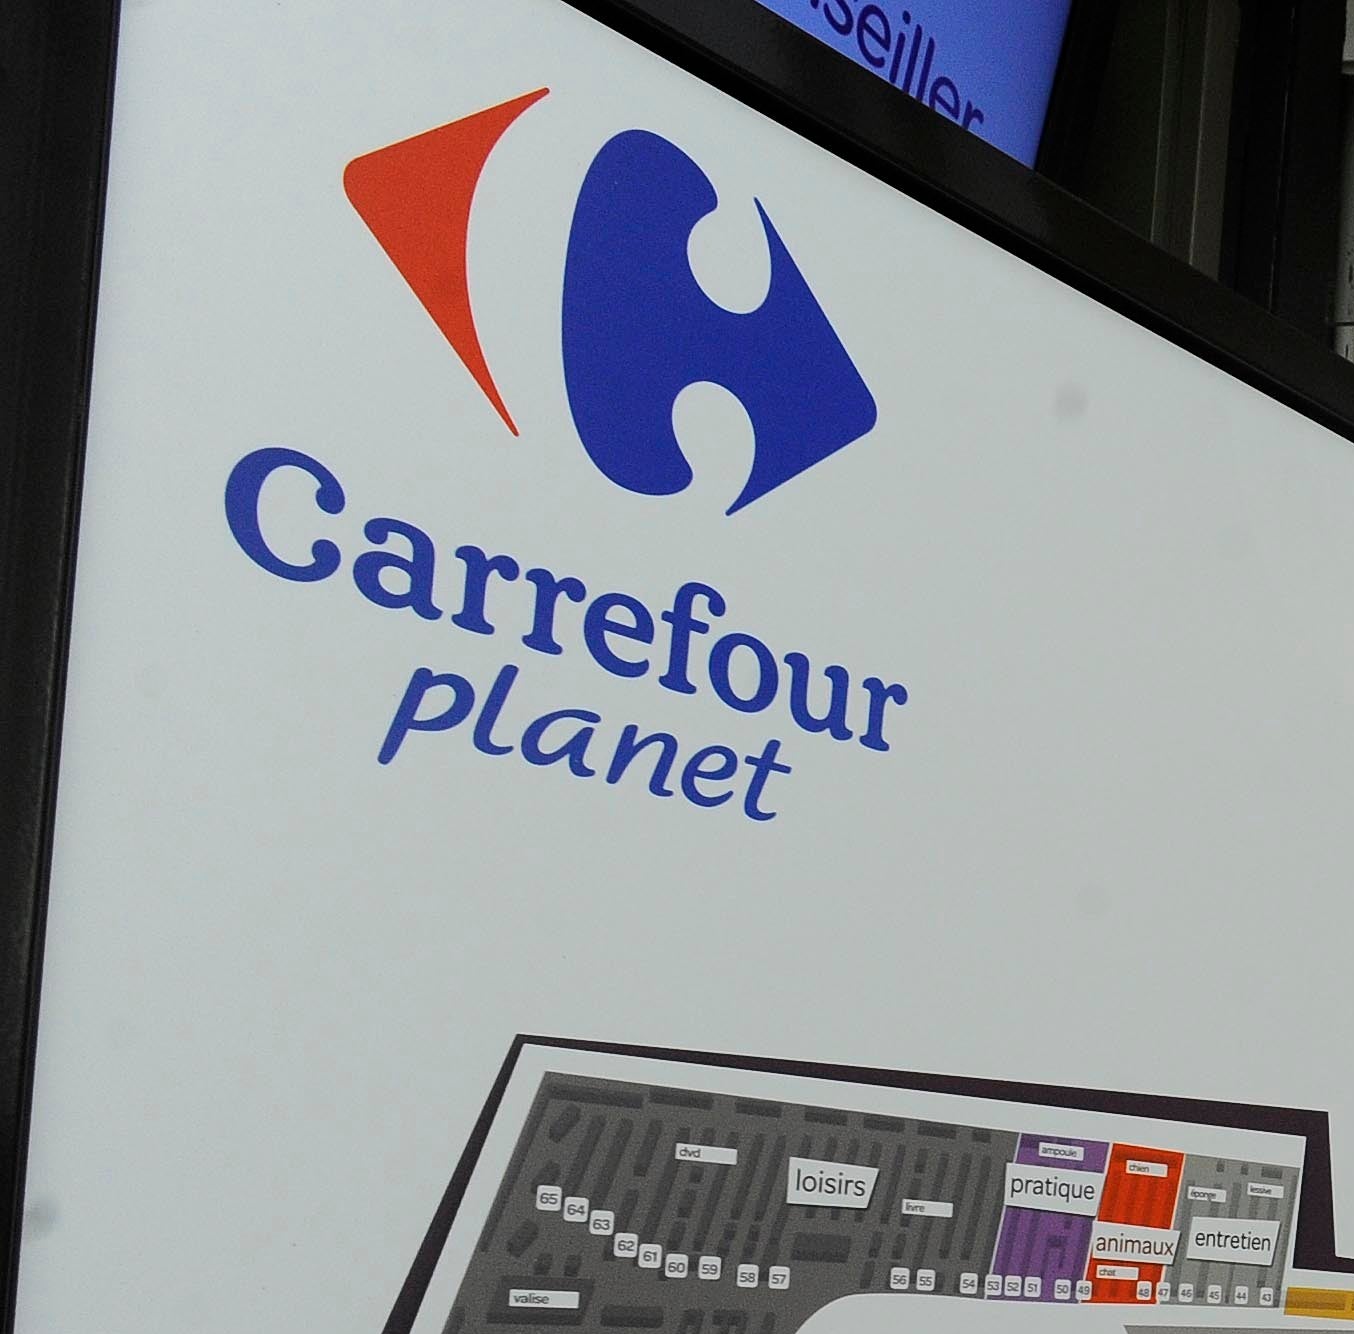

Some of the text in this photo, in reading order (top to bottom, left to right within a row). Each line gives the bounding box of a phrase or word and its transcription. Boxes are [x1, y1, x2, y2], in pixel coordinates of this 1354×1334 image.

[810, 0, 984, 131] seiller
[224, 446, 907, 752] Carrefour
[378, 663, 792, 821] planet
[679, 1146, 700, 1158] dvd
[1041, 1146, 1077, 1158] ampoule
[1129, 1163, 1150, 1173] chien
[795, 1169, 866, 1197] loisirs
[1010, 1176, 1095, 1203] pratique
[539, 1191, 559, 1206] 65
[566, 1203, 586, 1216] 64
[593, 1218, 611, 1231] 63
[617, 1239, 635, 1252] 62
[1095, 1232, 1174, 1256] animaux
[1194, 1230, 1271, 1251] entretien
[643, 1250, 658, 1263] 61
[667, 1261, 686, 1274] 60
[701, 1262, 719, 1275] 59
[739, 1271, 756, 1284] 58
[771, 1272, 787, 1285] 57
[892, 1273, 908, 1286] 56
[918, 1274, 934, 1287] 55
[962, 1277, 976, 1289] 54
[987, 1280, 1000, 1291] 53
[1007, 1281, 1020, 1292] 52
[1026, 1282, 1038, 1293] 51
[1057, 1284, 1069, 1294] 50
[1078, 1285, 1090, 1296] 49
[1157, 1287, 1169, 1296] 47
[513, 1292, 549, 1305] valise
[1181, 1288, 1193, 1298] 46
[1209, 1290, 1220, 1300] 45
[1236, 1291, 1246, 1301] 44
[1261, 1292, 1272, 1302] 43
